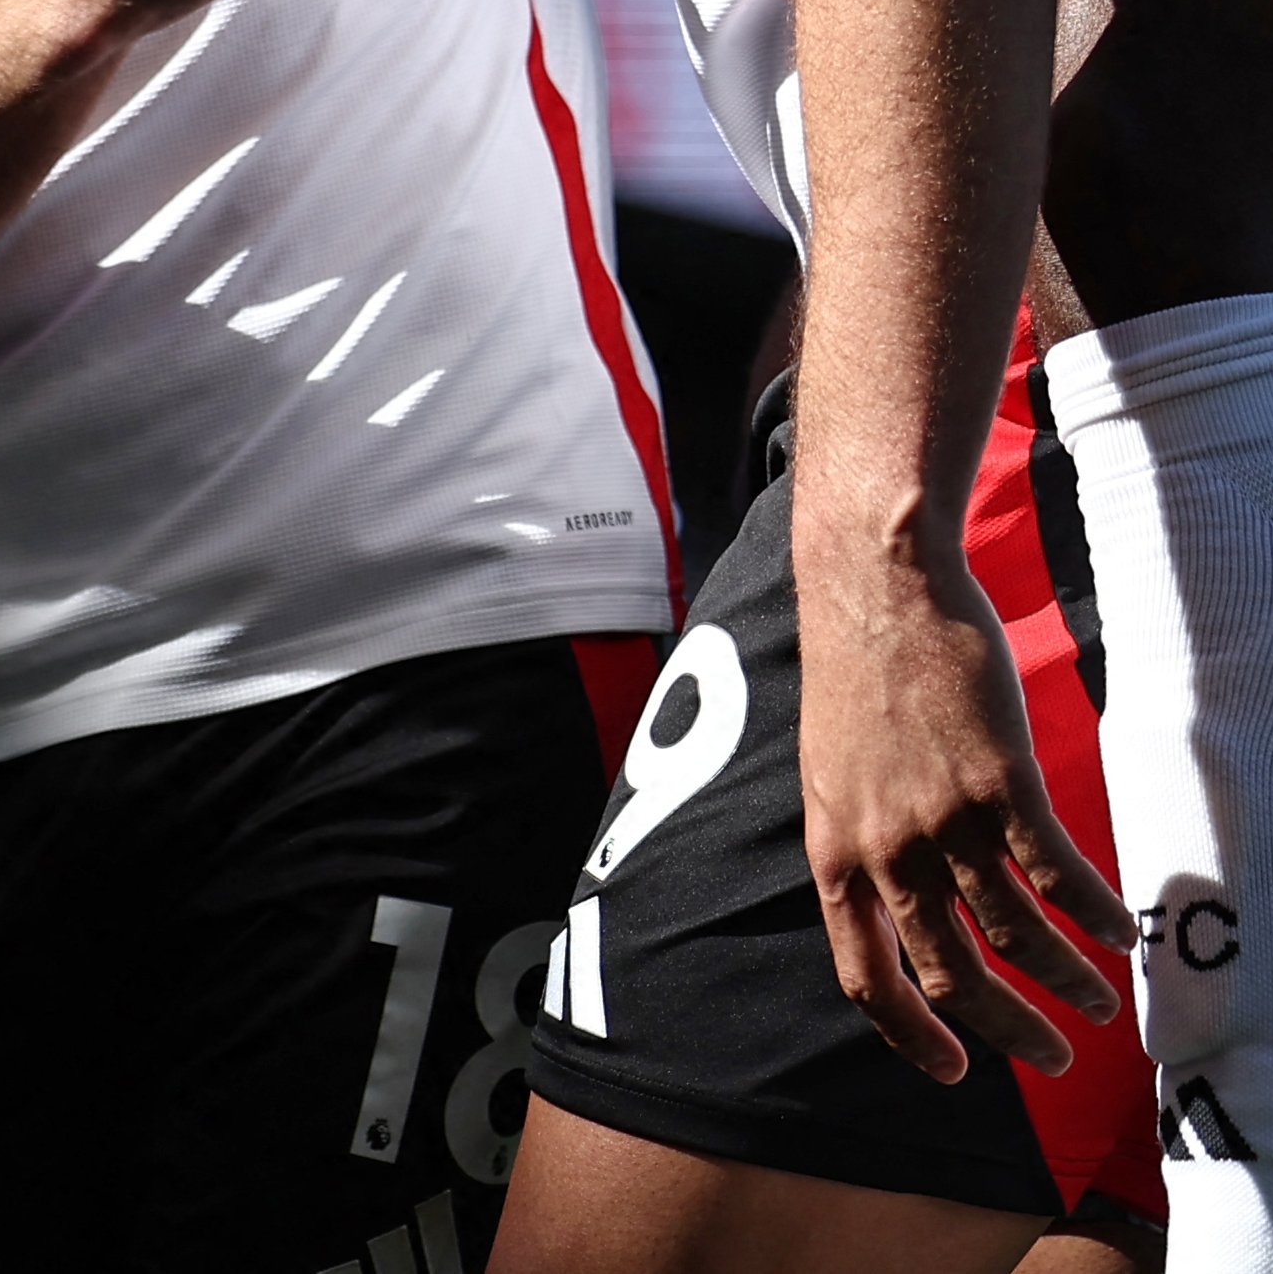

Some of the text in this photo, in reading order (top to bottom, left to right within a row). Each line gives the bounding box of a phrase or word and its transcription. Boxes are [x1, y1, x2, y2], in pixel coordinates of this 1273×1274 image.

[565, 510, 633, 532] AEROREADY
[583, 621, 748, 883] 9
[350, 894, 562, 1185] 18
